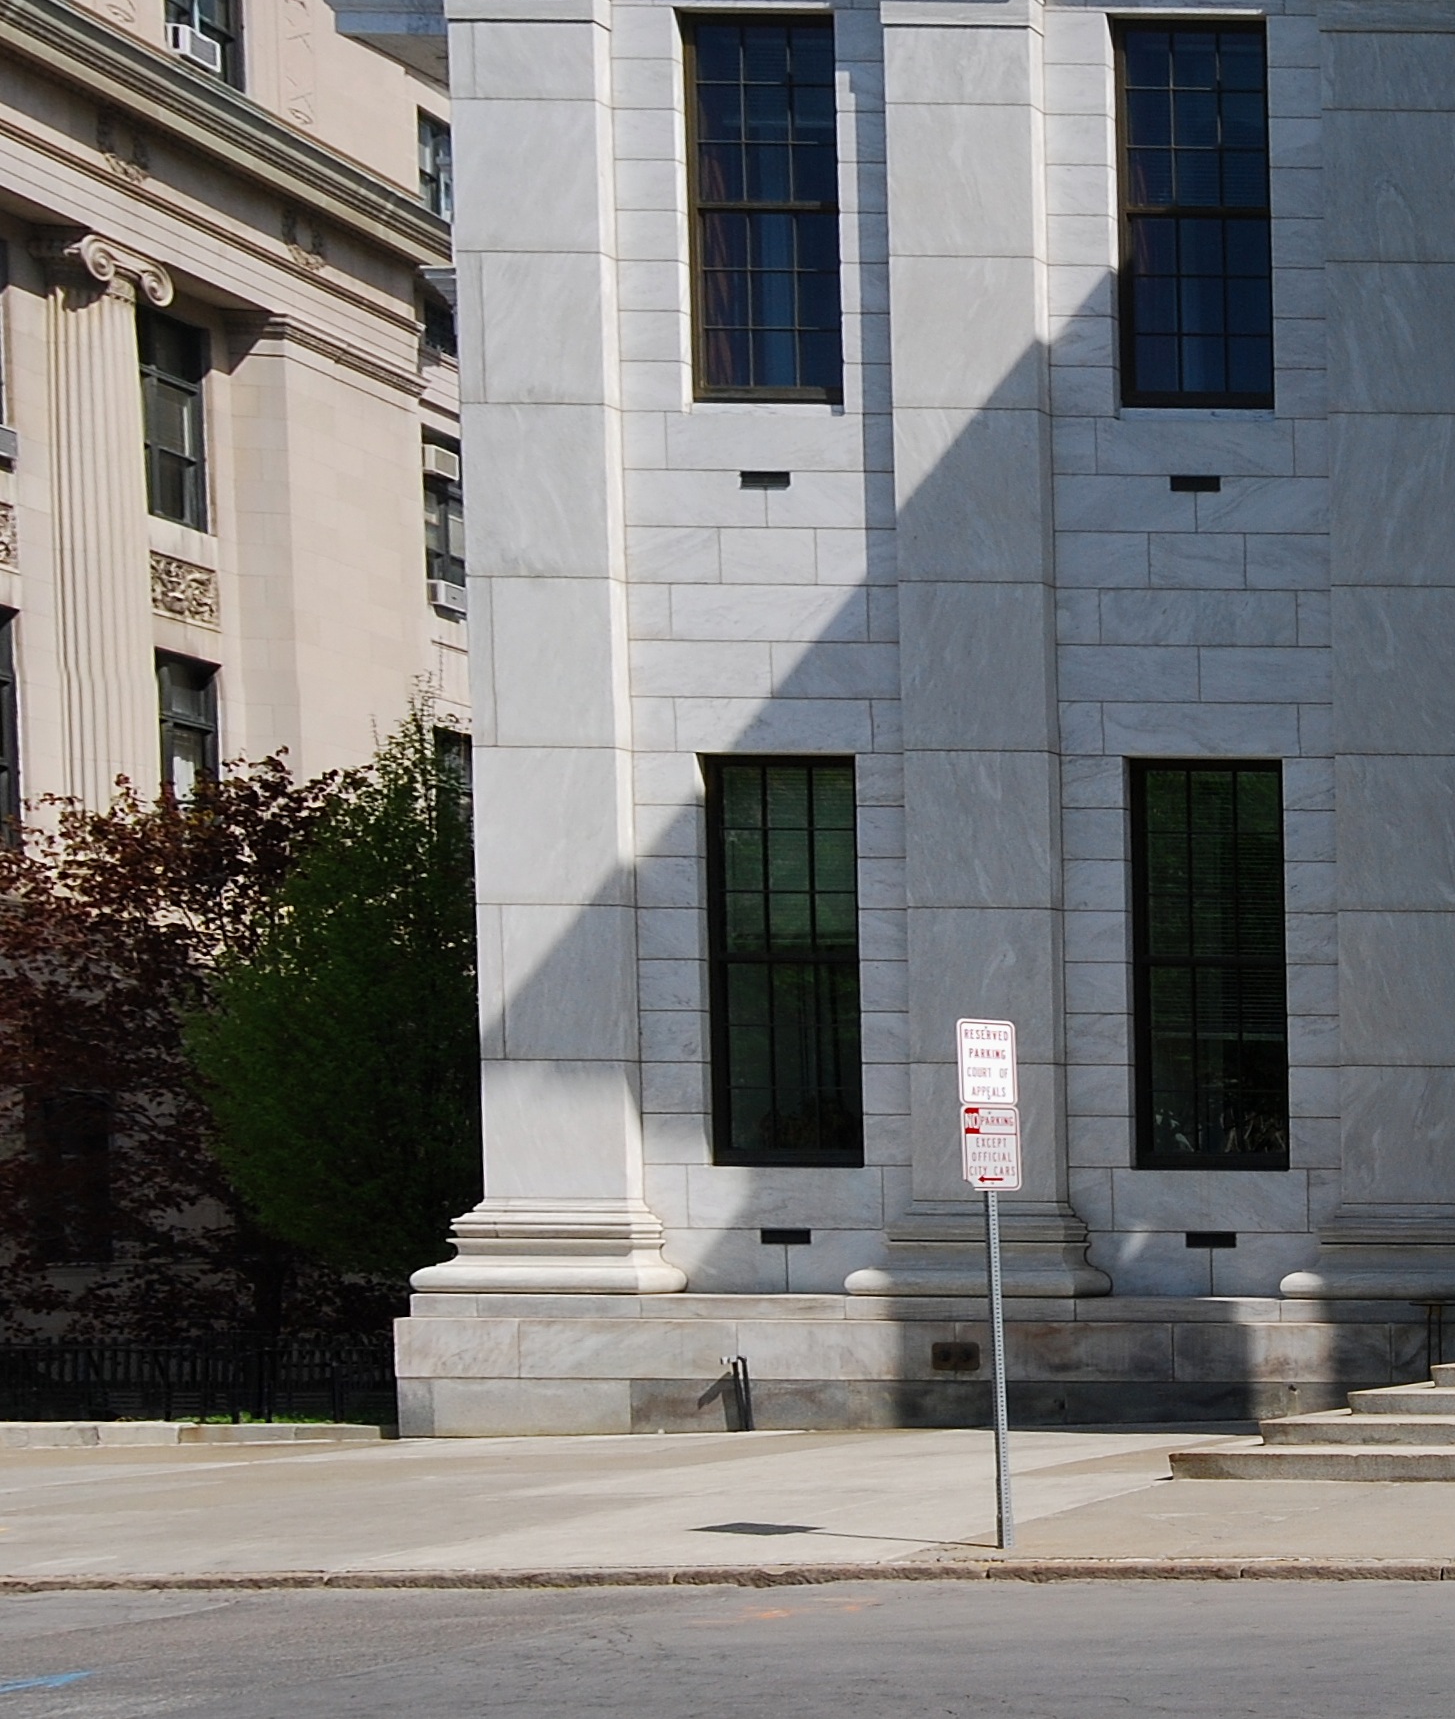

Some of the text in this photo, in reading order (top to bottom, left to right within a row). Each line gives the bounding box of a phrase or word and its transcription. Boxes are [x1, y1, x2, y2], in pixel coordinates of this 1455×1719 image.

[964, 1028, 1008, 1041] RESERVED
[968, 1048, 1006, 1060] PARKING
[967, 1067, 1008, 1078] COURT OF
[971, 1086, 1006, 1098] APPEALS
[964, 1113, 1014, 1128] NO PARKING
[976, 1138, 1007, 1149] EXCEPT
[971, 1151, 1012, 1163] OFFICIAL
[969, 1165, 1016, 1177] CITY CARS
